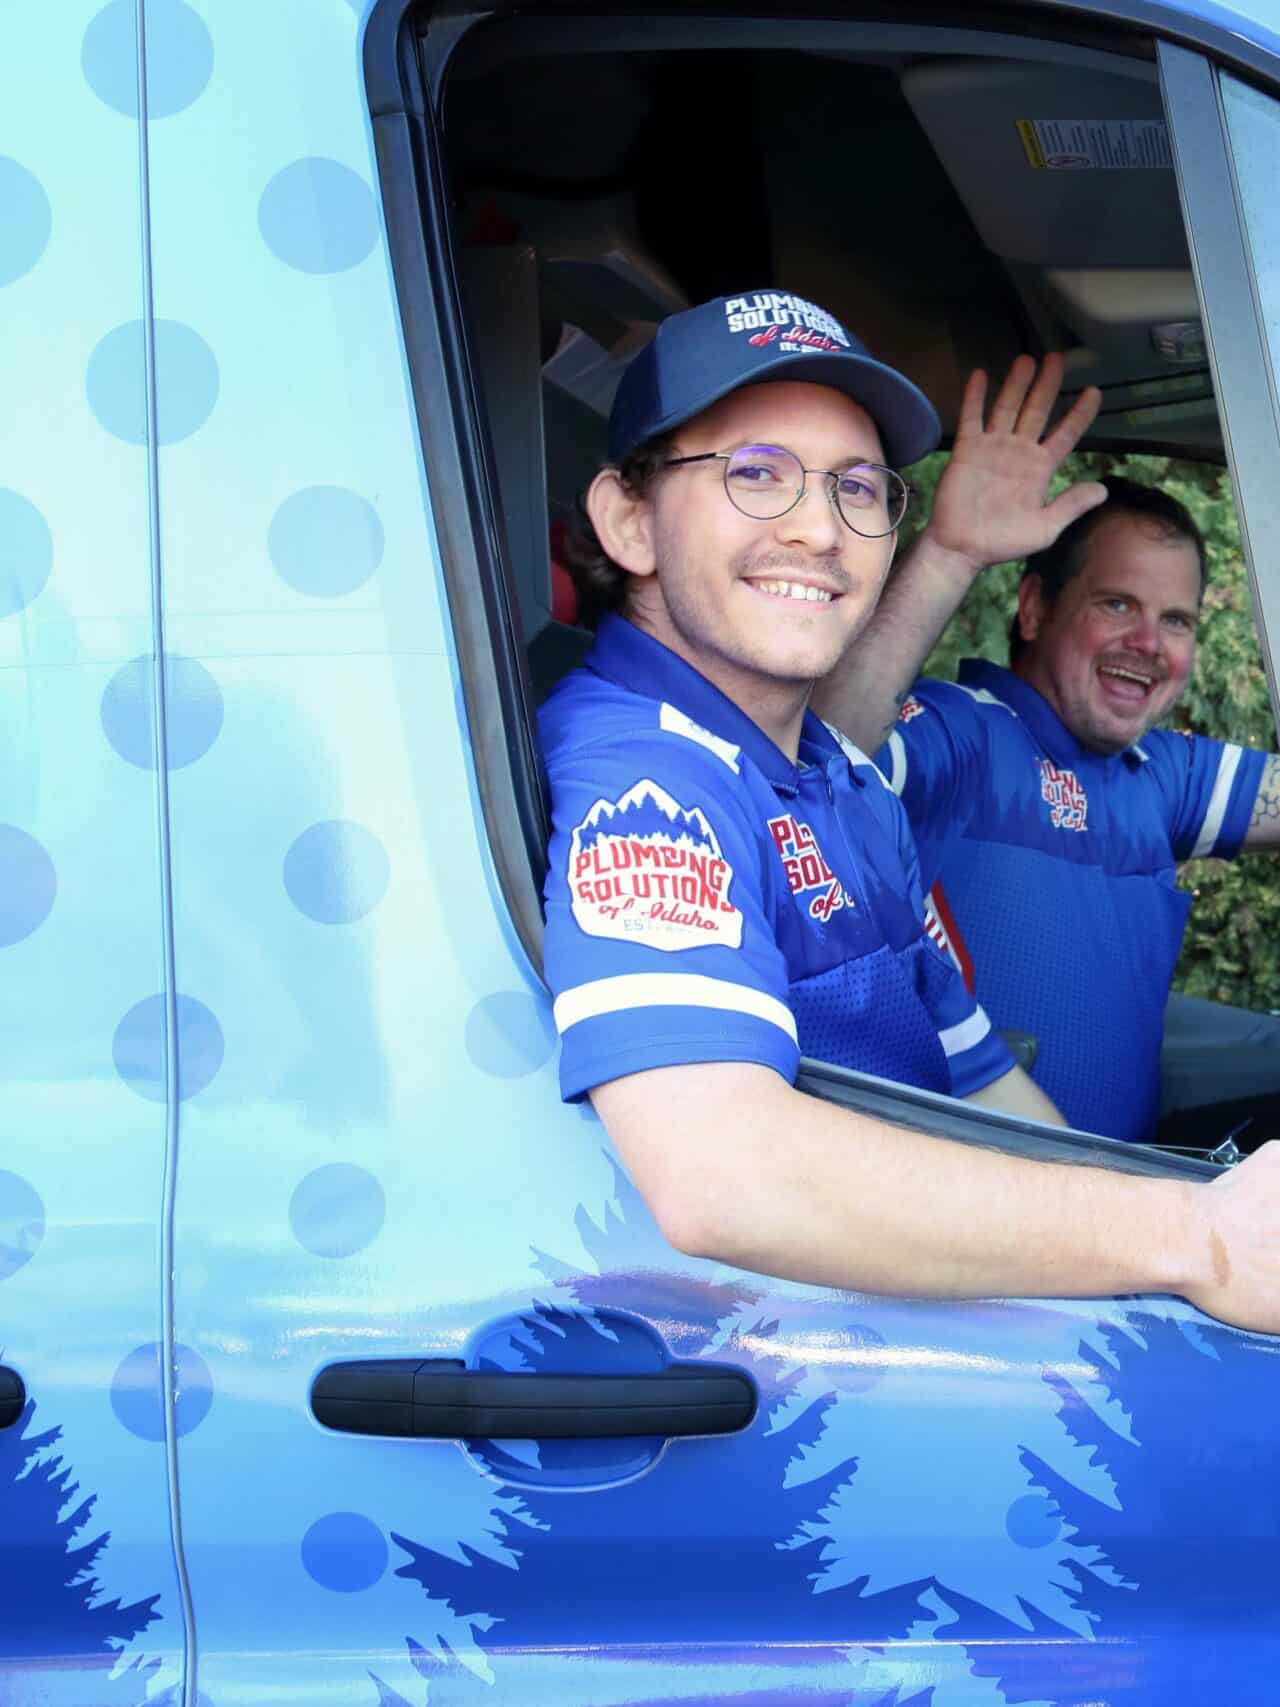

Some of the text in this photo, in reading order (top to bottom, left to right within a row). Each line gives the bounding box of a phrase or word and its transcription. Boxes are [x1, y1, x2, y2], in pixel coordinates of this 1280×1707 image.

[748, 325, 779, 346] of
[576, 840, 726, 891] PLUMBING
[598, 899, 635, 920] of
[641, 902, 719, 931] Idaho
[812, 882, 841, 919] of
